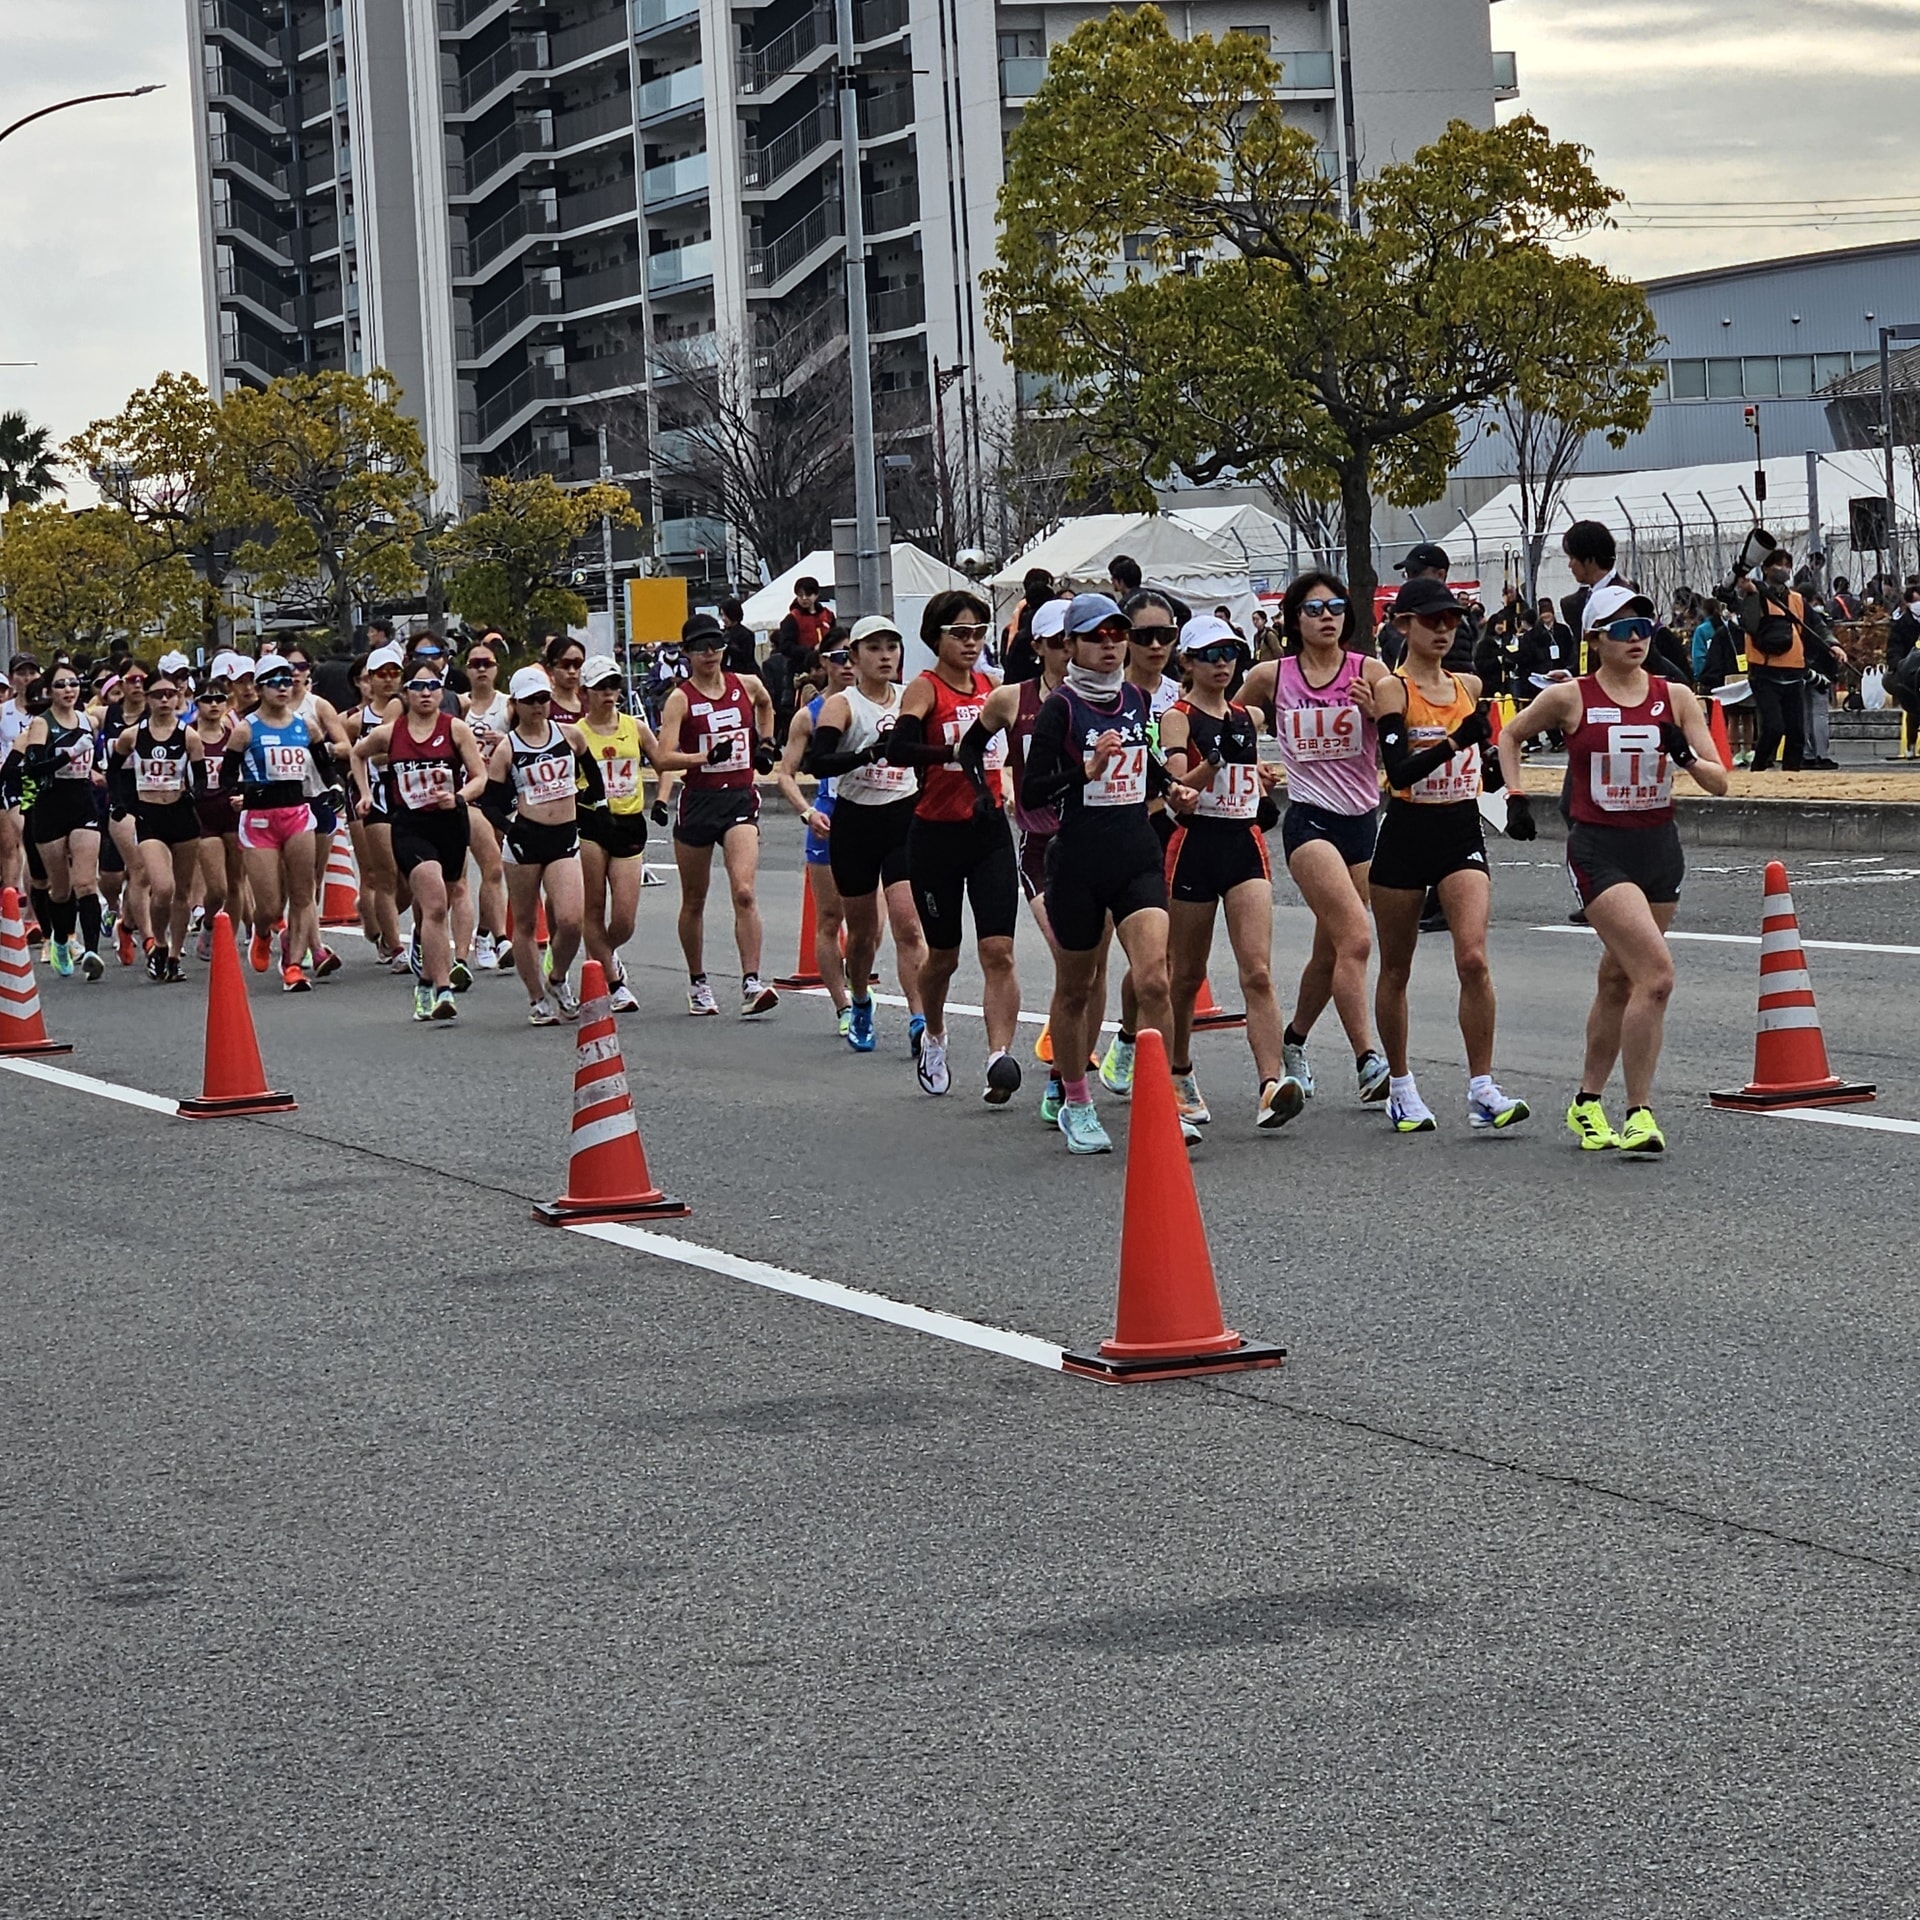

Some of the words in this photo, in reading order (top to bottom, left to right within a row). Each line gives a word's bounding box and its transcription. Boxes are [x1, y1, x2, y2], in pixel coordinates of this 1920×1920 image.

[1085, 722, 1144, 747] 香大学
[1293, 709, 1354, 739] 116
[1297, 738, 1318, 750] 石田
[141, 760, 177, 777] 103
[270, 747, 306, 766] 108
[403, 769, 447, 793] 110
[525, 759, 569, 787] 102
[1601, 754, 1668, 786] 111
[1216, 795, 1236, 806] 大山
